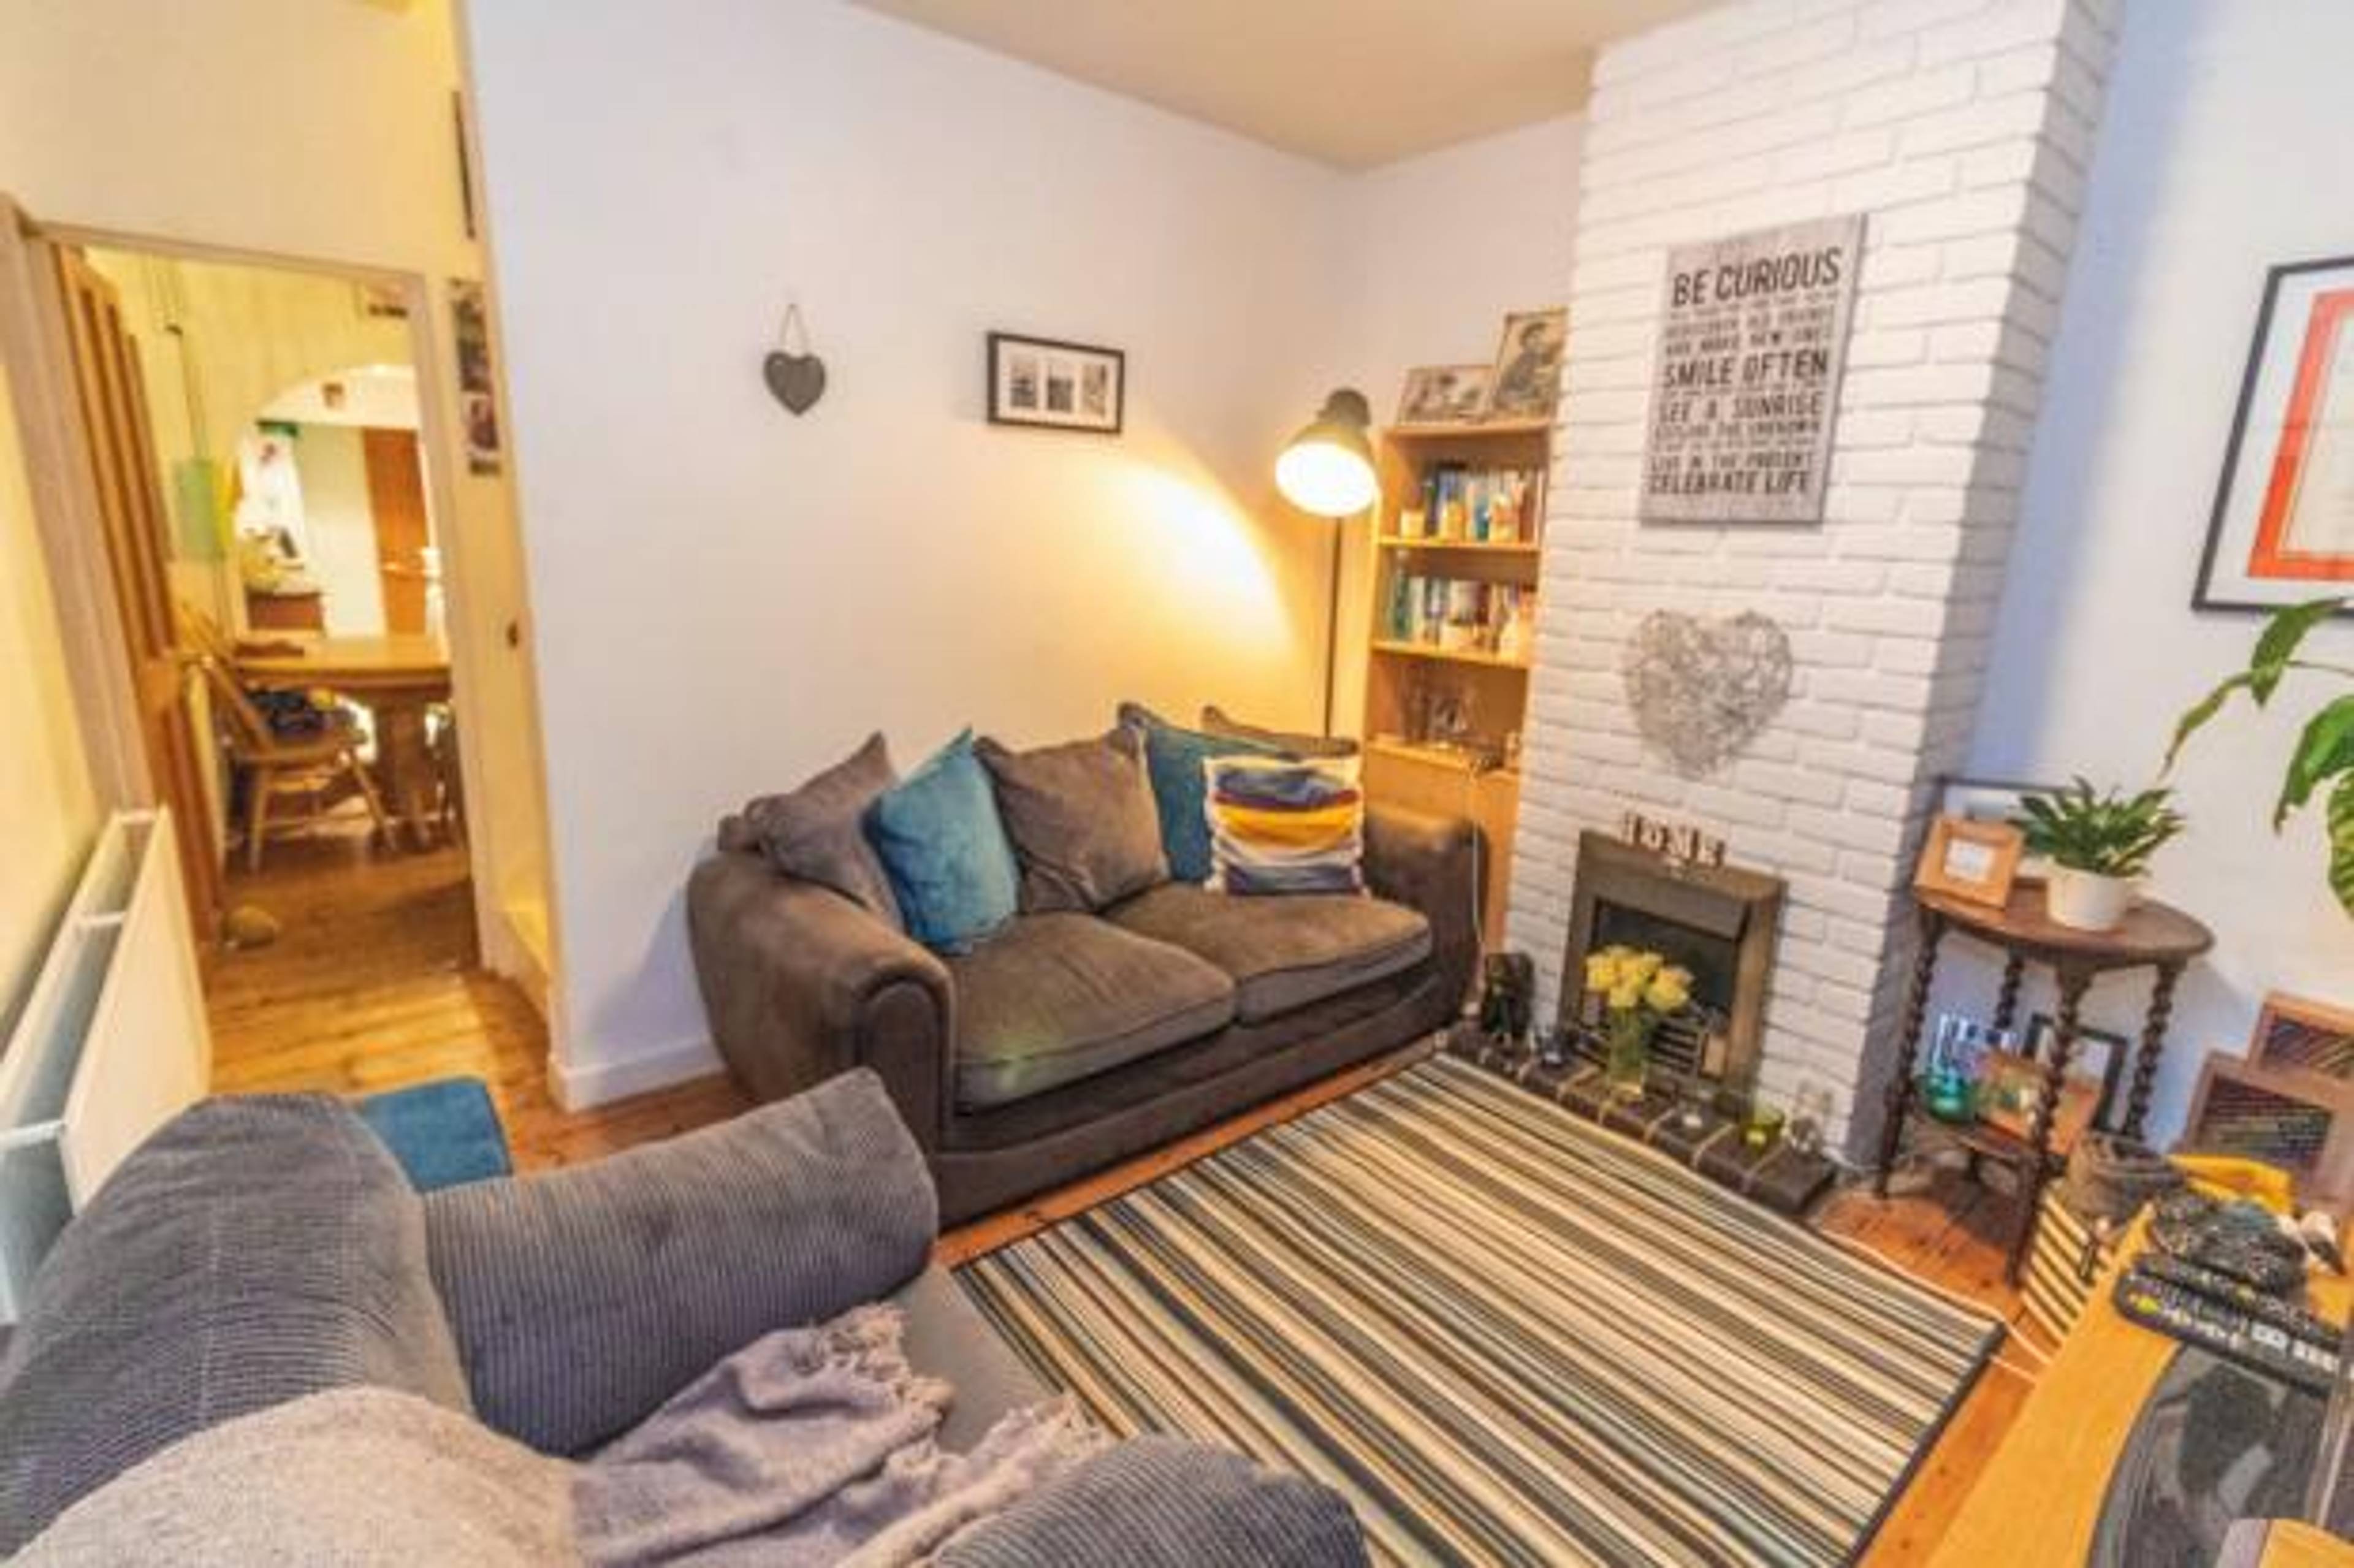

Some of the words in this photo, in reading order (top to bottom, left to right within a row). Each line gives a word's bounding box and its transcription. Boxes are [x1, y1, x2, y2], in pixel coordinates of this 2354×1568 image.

[1672, 273, 1711, 305] BE
[1716, 247, 1841, 300] CURIOUS
[1664, 357, 1735, 387] SMILE
[1744, 349, 1828, 379] OFTEN
[1732, 392, 1824, 418] SUNRISE
[1648, 471, 1758, 495] CELEBRATE
[1764, 469, 1810, 493] LIFE
